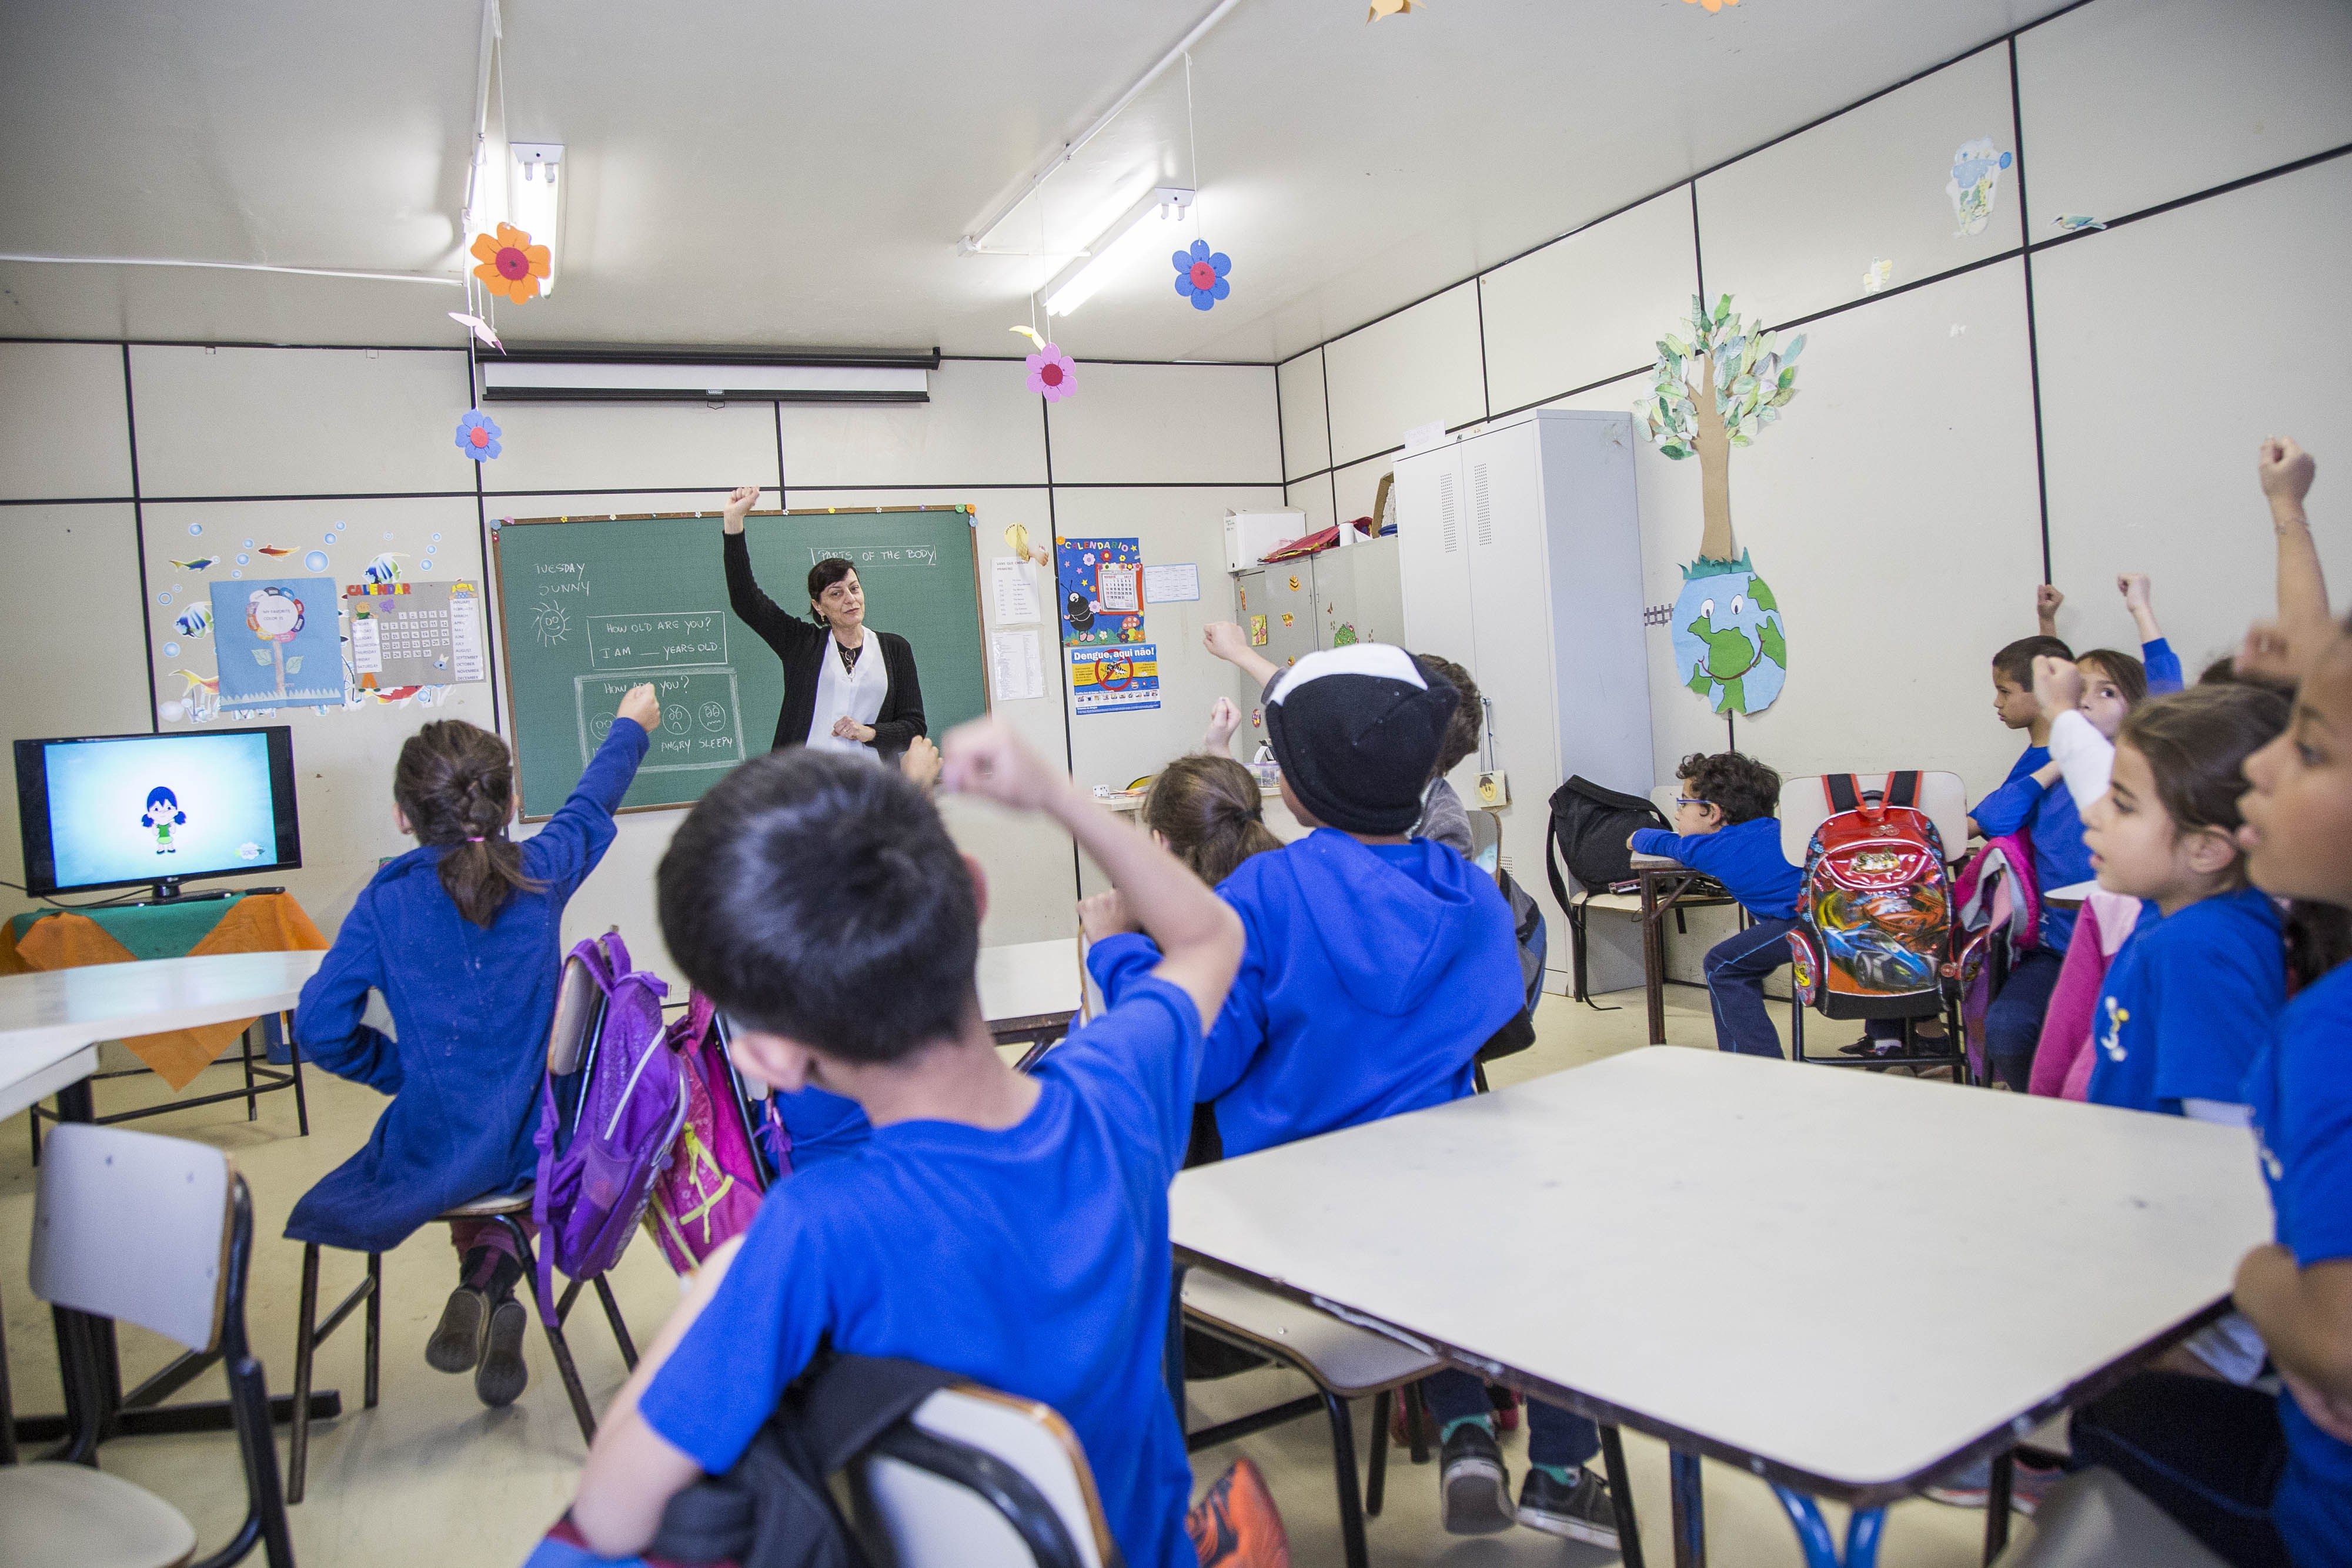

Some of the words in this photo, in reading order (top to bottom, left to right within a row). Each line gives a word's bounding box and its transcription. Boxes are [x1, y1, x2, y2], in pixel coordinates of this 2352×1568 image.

[818, 550, 853, 560] PARTS
[863, 552, 875, 561] OF
[880, 551, 900, 559] THE
[906, 550, 934, 564] BODY
[532, 563, 585, 580] TUESDAY
[347, 583, 411, 596] CALENDAR
[539, 581, 590, 596] SUNNY
[607, 623, 626, 633] HOW
[632, 623, 652, 633] OLD
[658, 621, 679, 630] ARE
[684, 617, 711, 635] YOU?
[599, 648, 610, 658] I
[614, 647, 631, 656] AM
[663, 644, 694, 660] YEARS
[1074, 651, 1112, 661] Dengue,
[1114, 649, 1132, 658] aqui
[1134, 647, 1154, 656] não!
[604, 683, 626, 694] HOW
[659, 675, 689, 697] YOU?
[661, 739, 690, 753] ANGRY
[699, 737, 733, 748] SLEEPY
